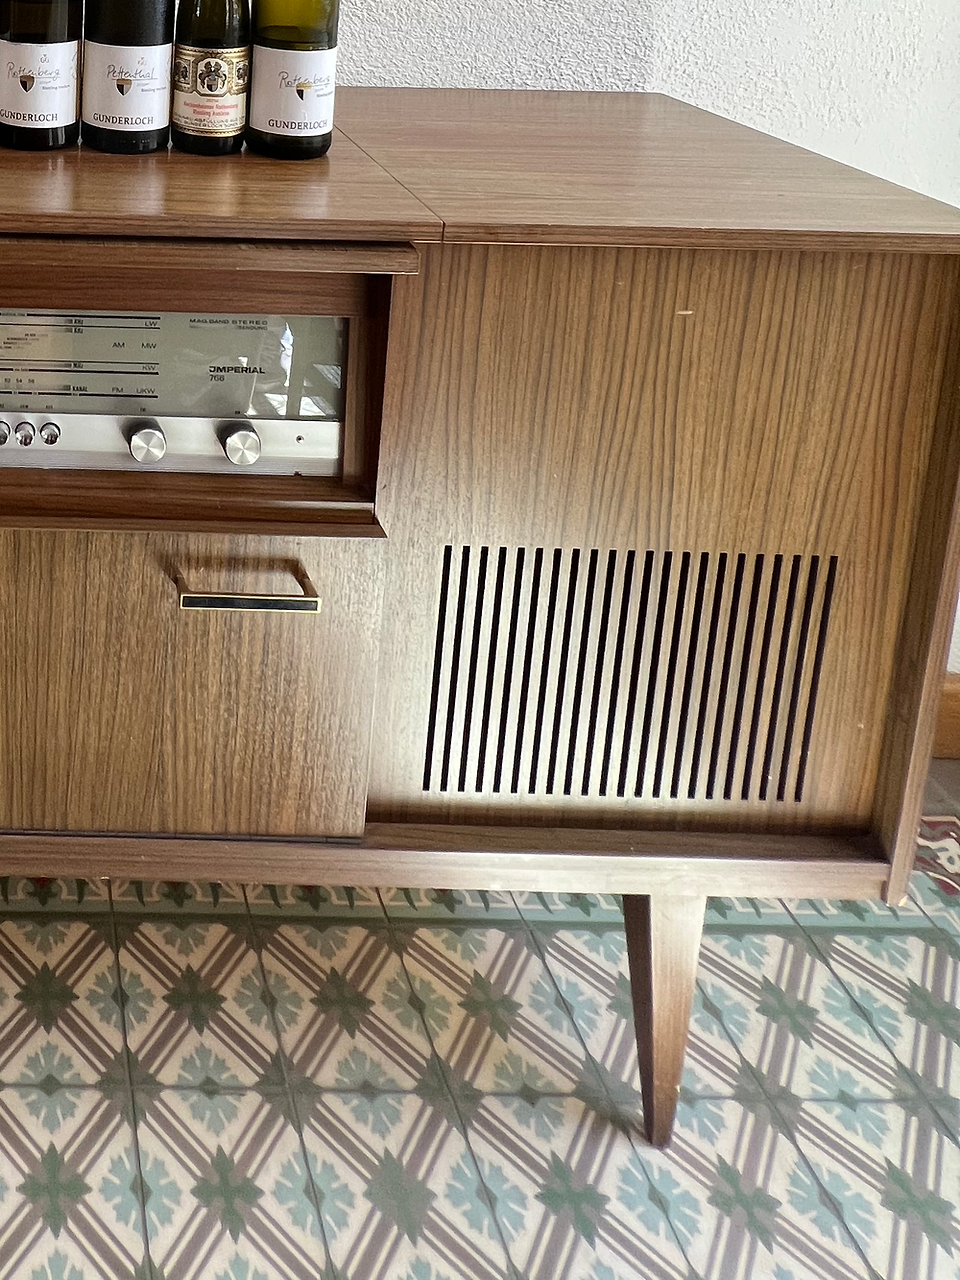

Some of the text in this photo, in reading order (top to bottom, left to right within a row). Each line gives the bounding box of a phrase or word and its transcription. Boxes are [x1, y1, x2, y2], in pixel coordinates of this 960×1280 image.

[0, 109, 58, 122] GUNDERLOCH
[93, 113, 154, 125] GUNDERLOCH
[268, 119, 328, 130] GUNDERLOCH
